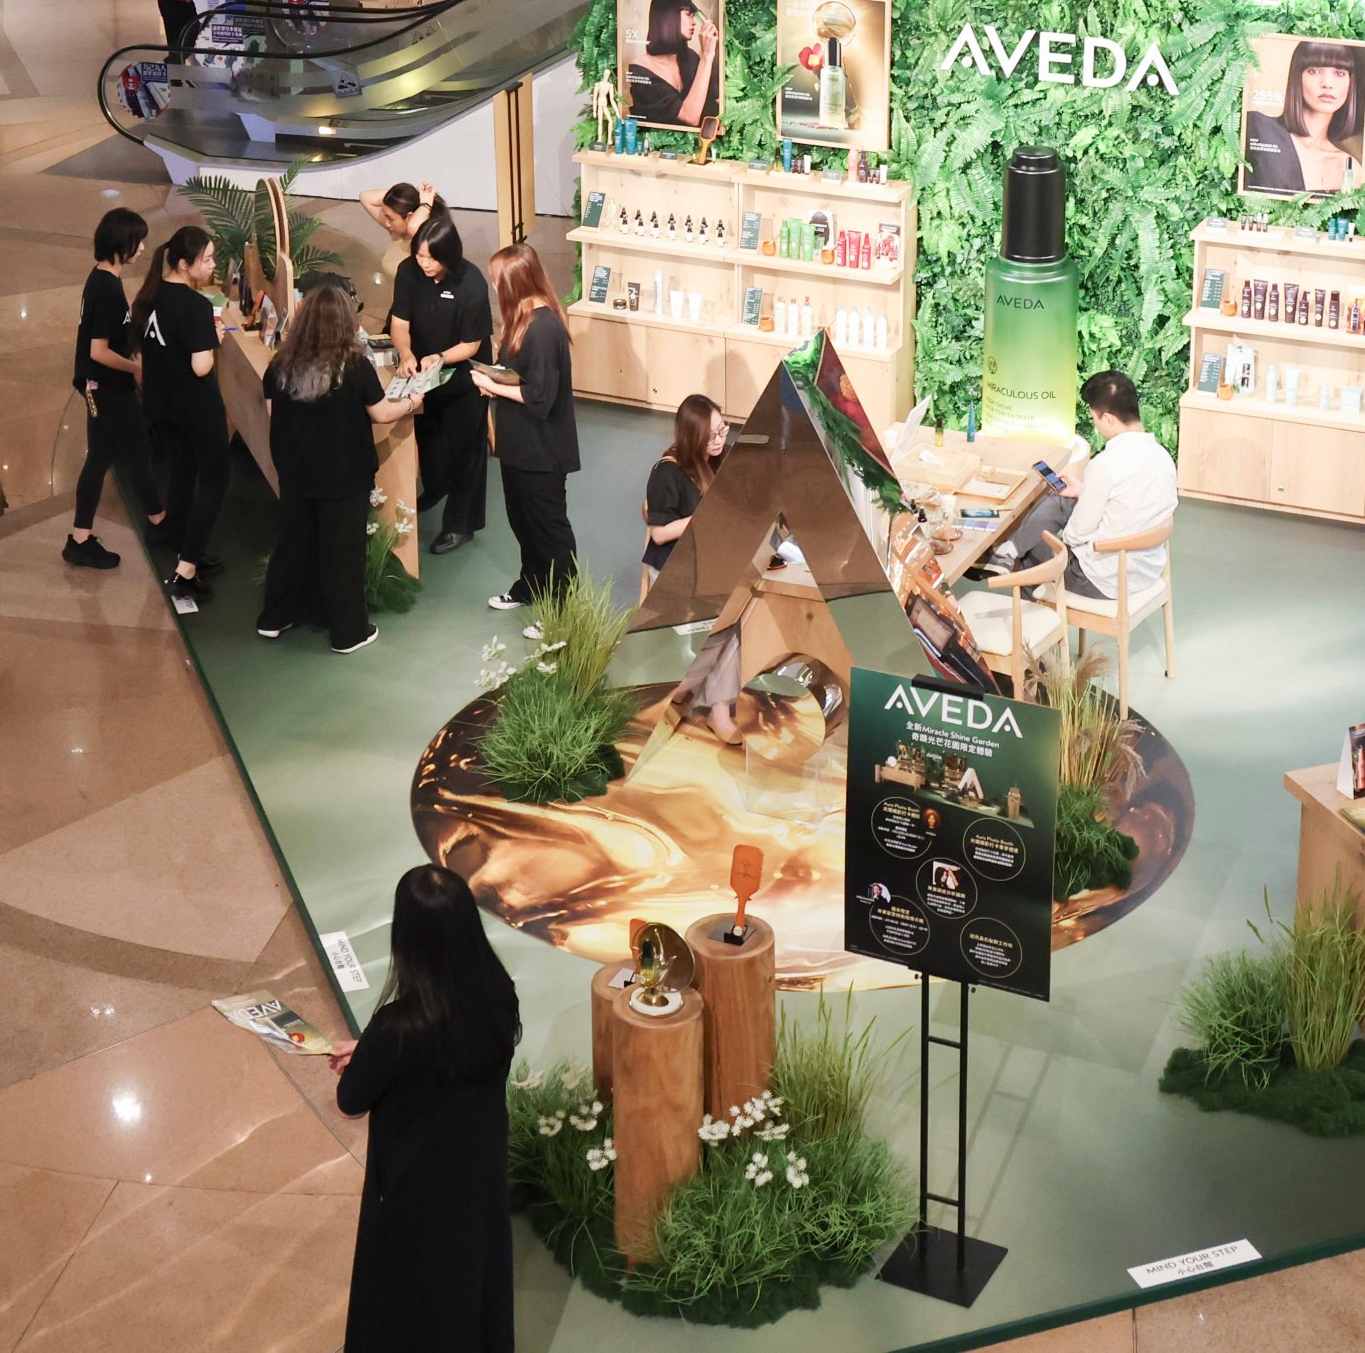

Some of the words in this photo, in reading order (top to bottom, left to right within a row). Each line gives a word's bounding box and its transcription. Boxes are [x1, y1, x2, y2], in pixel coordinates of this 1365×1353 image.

[625, 29, 639, 39] 5X
[940, 22, 1180, 96] AVEDA
[997, 294, 1045, 309] AVEDA
[987, 381, 1039, 400] MIRACULOUS
[1041, 391, 1056, 400] OIL
[884, 683, 1023, 739] AVEDA
[950, 730, 971, 743] Shine
[971, 736, 1000, 748] Garden
[349, 968, 363, 983] STEP
[1147, 1262, 1177, 1275] MIND
[1178, 1254, 1211, 1266] YOUR
[1212, 1245, 1238, 1257] STEP
